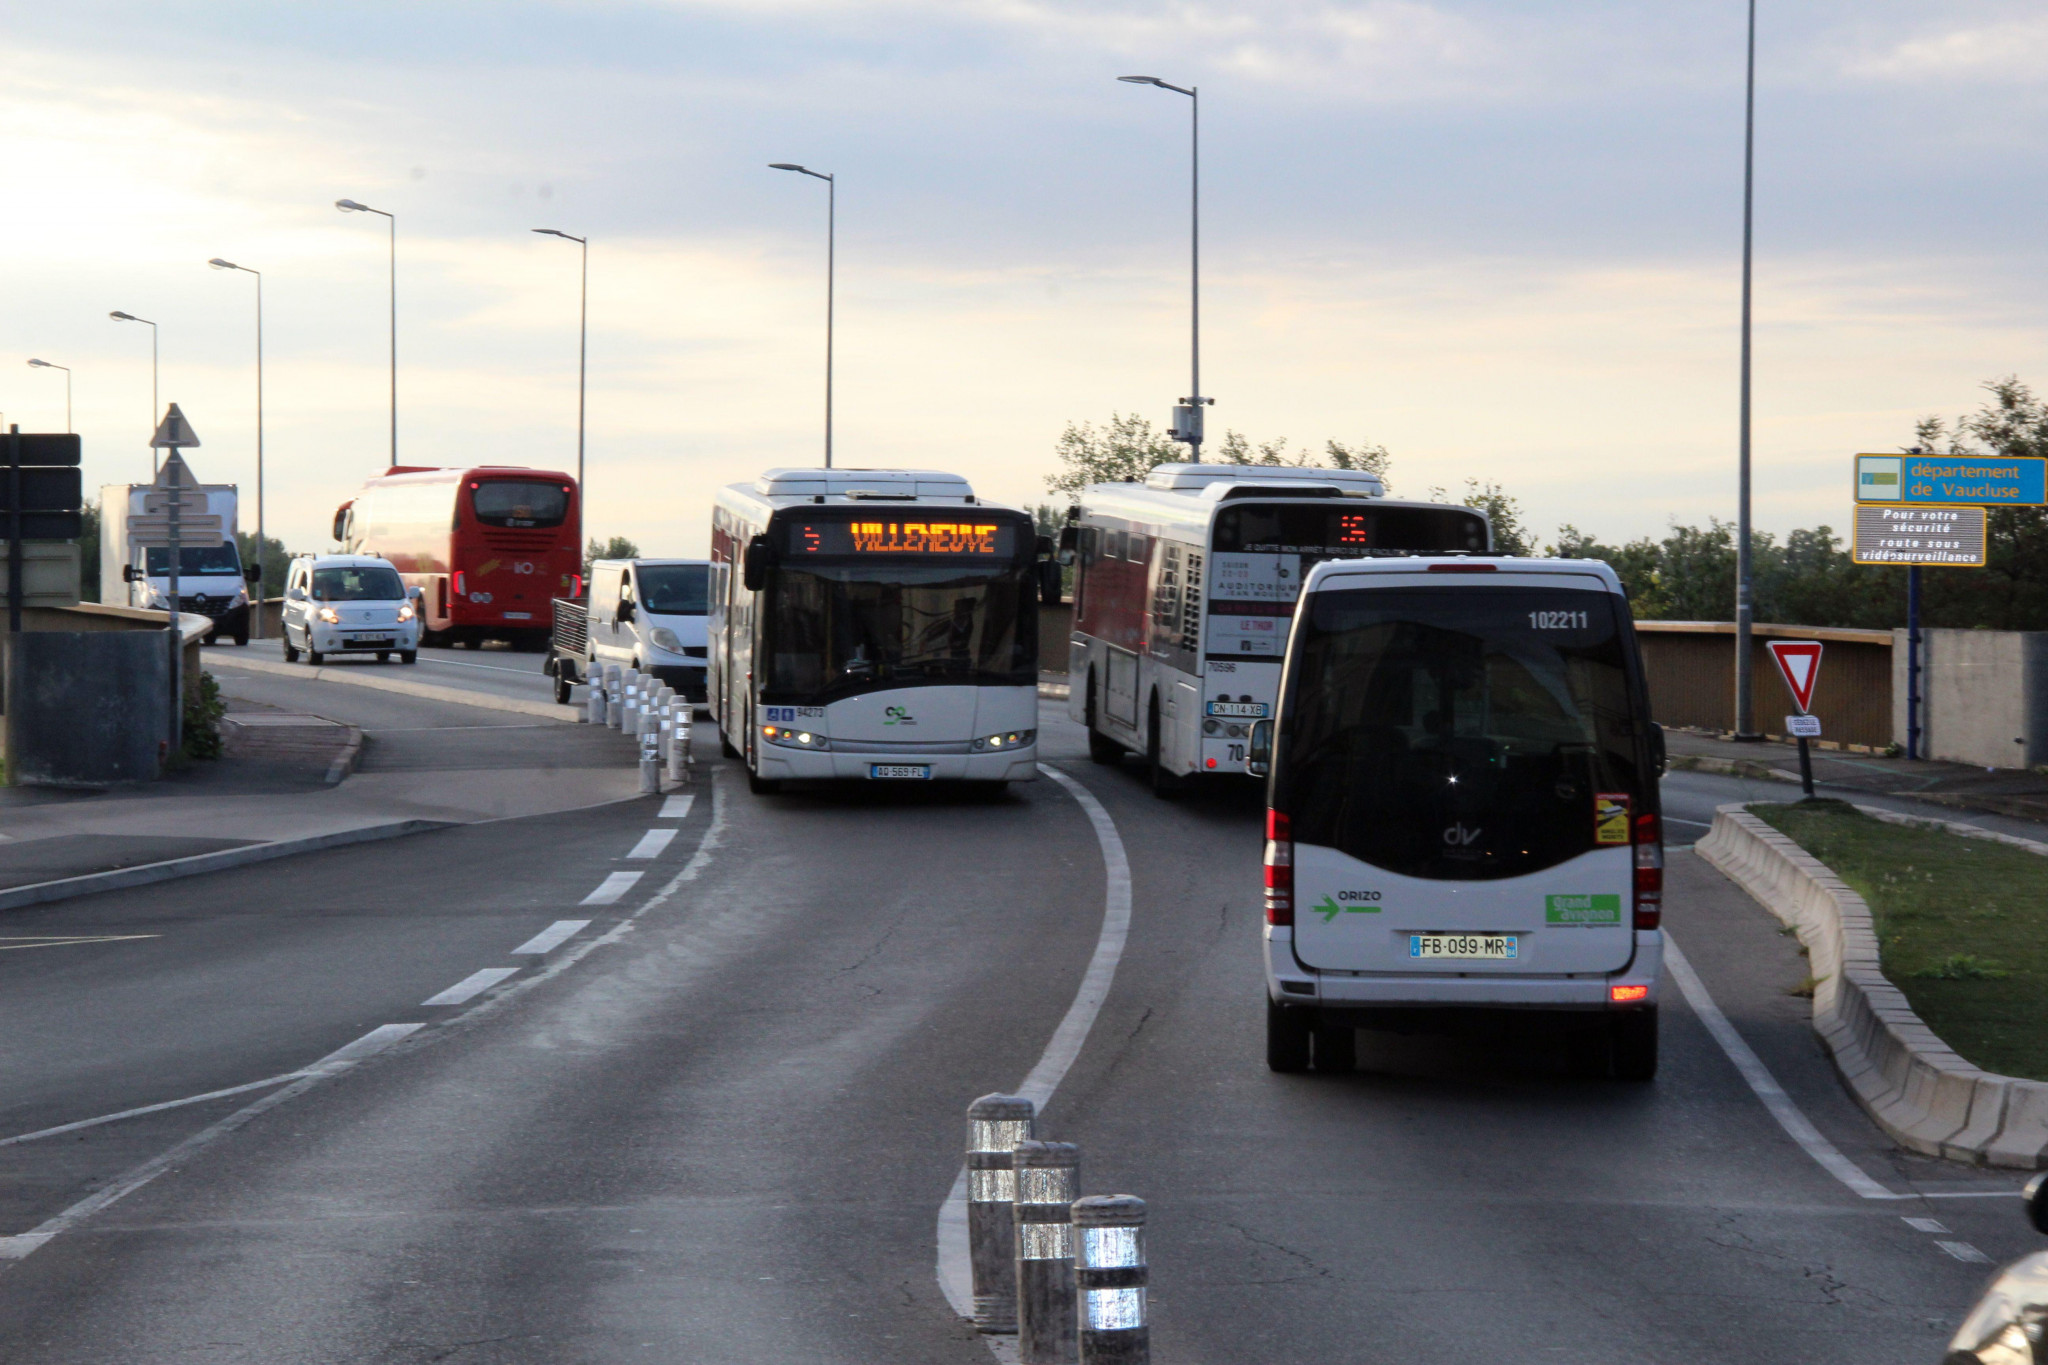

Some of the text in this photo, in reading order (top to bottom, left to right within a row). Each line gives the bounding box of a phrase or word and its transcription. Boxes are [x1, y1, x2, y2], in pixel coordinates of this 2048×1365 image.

[1911, 462, 2020, 481] département
[1911, 482, 2020, 498] de Vaucluse
[1883, 509, 1958, 521] Pour votre
[1892, 522, 1950, 533] sécurité
[851, 522, 998, 553] VILLENEUVE
[1880, 538, 1960, 549] route sous
[1254, 543, 1280, 551] QUITTE
[1861, 550, 1977, 562] vidéosurveillance
[1218, 582, 1297, 592] AUDITORIUM
[1240, 620, 1250, 631] LE
[1528, 610, 1588, 629] 102211
[1338, 890, 1382, 901] ORIZO
[1553, 894, 1592, 912] grand
[1561, 909, 1615, 921] avignon
